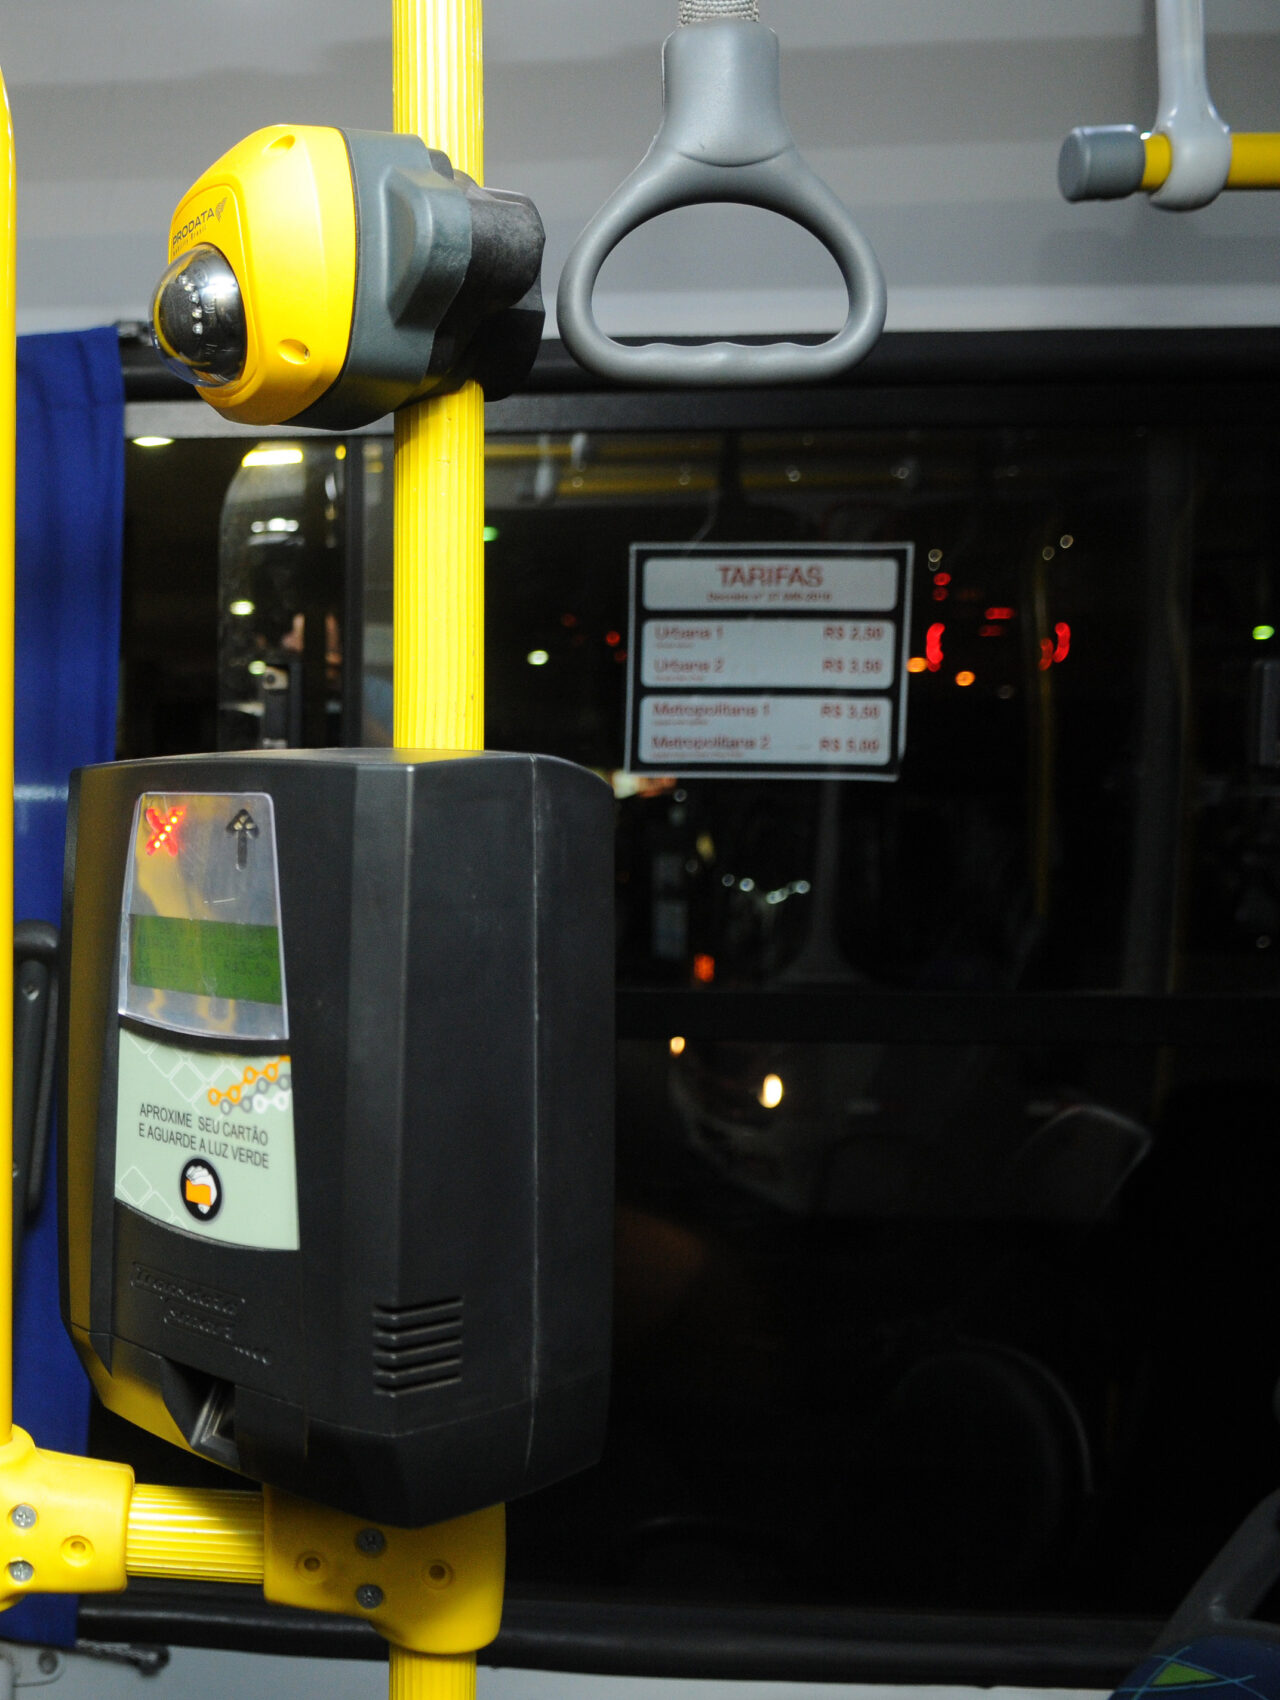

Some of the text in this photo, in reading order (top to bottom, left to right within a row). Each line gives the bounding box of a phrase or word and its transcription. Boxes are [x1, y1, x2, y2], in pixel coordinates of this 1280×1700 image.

[173, 208, 215, 248] PRODATA
[718, 565, 823, 588] TARIFAS
[655, 625, 724, 640] Urbana 1
[823, 625, 844, 641] R$
[654, 657, 724, 673] Urbana 2
[822, 658, 844, 674] R$
[820, 704, 842, 719] R$
[760, 735, 770, 750] 2
[819, 738, 840, 753] R$
[140, 1103, 269, 1147] APROXIME SEU CARTÃO
[139, 1122, 269, 1169] E AGUARDE A LUZ VERDE
